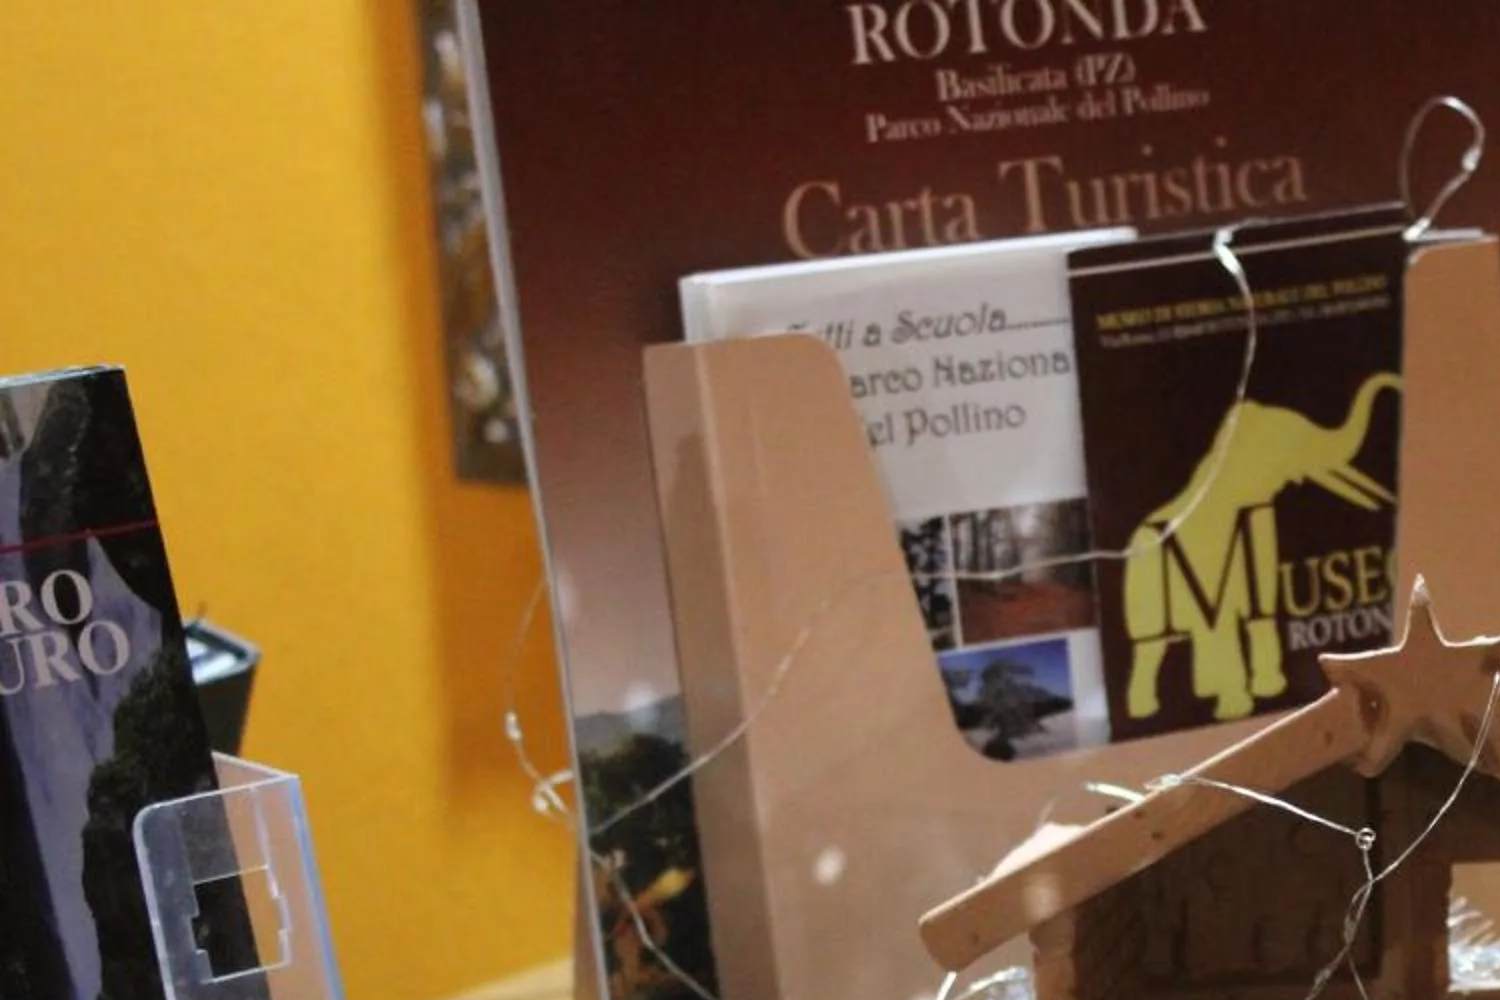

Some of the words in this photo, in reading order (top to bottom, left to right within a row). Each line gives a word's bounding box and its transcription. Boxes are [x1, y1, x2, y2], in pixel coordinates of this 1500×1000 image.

[846, 0, 1208, 65] ROTONDA
[936, 63, 1068, 102] Basilicata
[1075, 52, 1136, 89] (PZ)
[866, 113, 941, 144] Parco
[947, 95, 1069, 134] Nazionale
[1077, 90, 1117, 121] del
[1123, 82, 1210, 116] Pollino
[783, 180, 982, 259] Carta
[1000, 136, 1308, 232] Turistica
[863, 322, 881, 347] a
[891, 302, 1007, 345] Scuola
[849, 367, 923, 399] arco
[933, 350, 1071, 388] Naziona
[867, 412, 895, 449] el
[904, 402, 1026, 447] Pollino
[1288, 602, 1393, 651] ROTON
